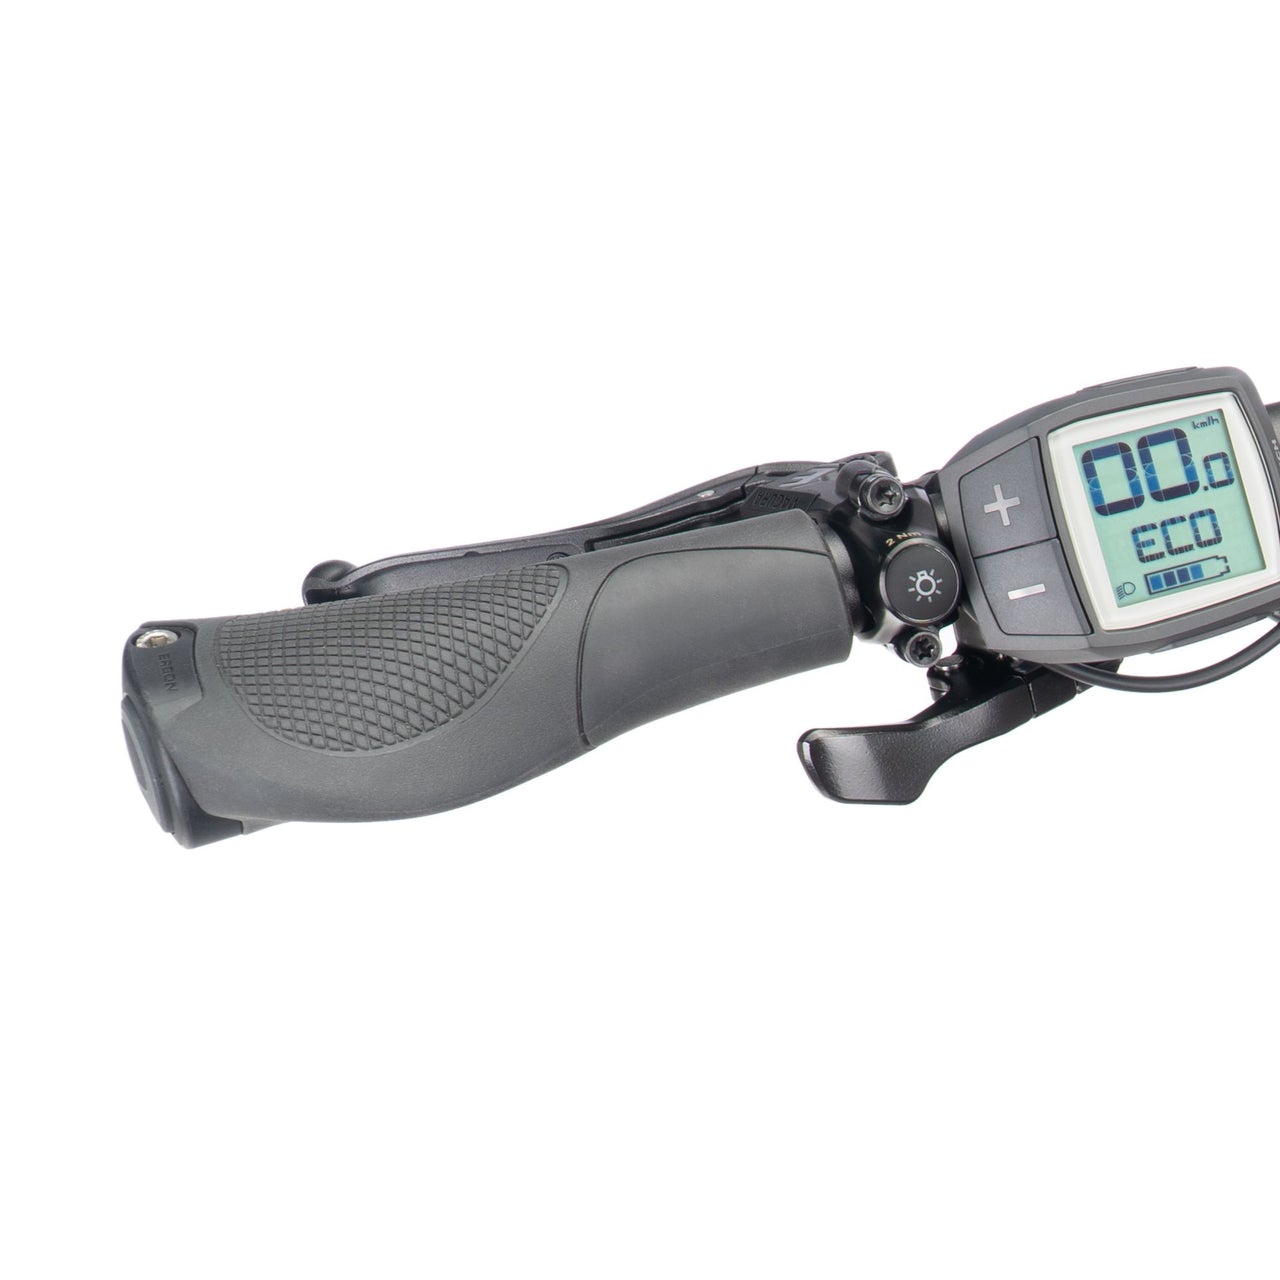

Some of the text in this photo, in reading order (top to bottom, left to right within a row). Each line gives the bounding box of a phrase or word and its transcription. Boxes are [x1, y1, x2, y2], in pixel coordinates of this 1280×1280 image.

[1191, 414, 1220, 432] km/h
[1131, 508, 1223, 563] ECO
[158, 652, 179, 692] ERGON
